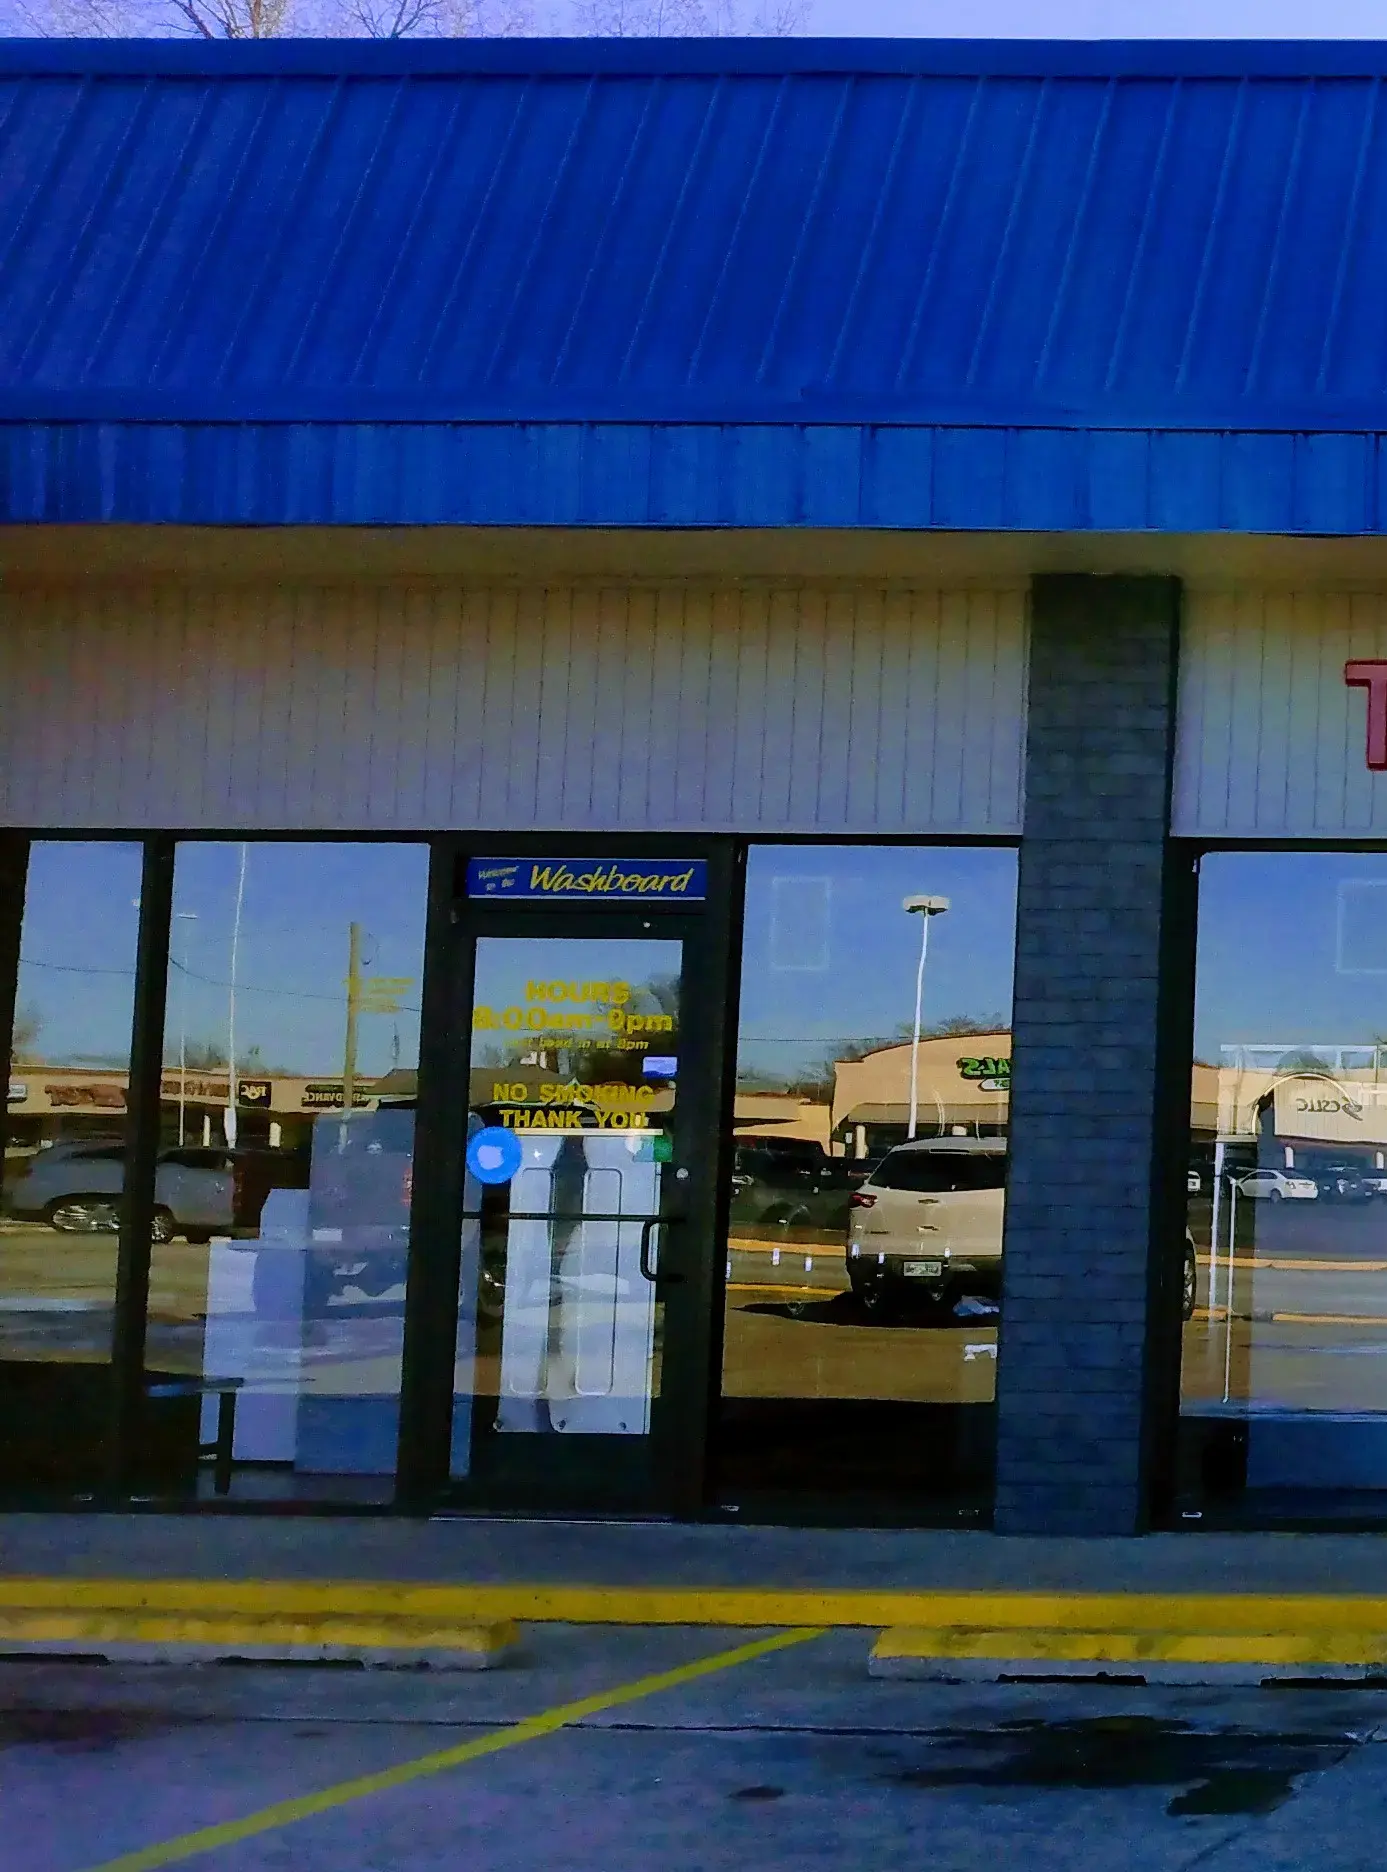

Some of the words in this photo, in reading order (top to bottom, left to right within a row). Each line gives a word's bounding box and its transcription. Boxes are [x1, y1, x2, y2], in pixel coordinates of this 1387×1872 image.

[529, 864, 695, 893] Washboard
[525, 979, 632, 1004] HOURS
[493, 1082, 528, 1101] NO
[539, 1083, 656, 1104] SMOKING
[499, 1108, 583, 1129] THANK
[594, 1110, 650, 1130] YOU
